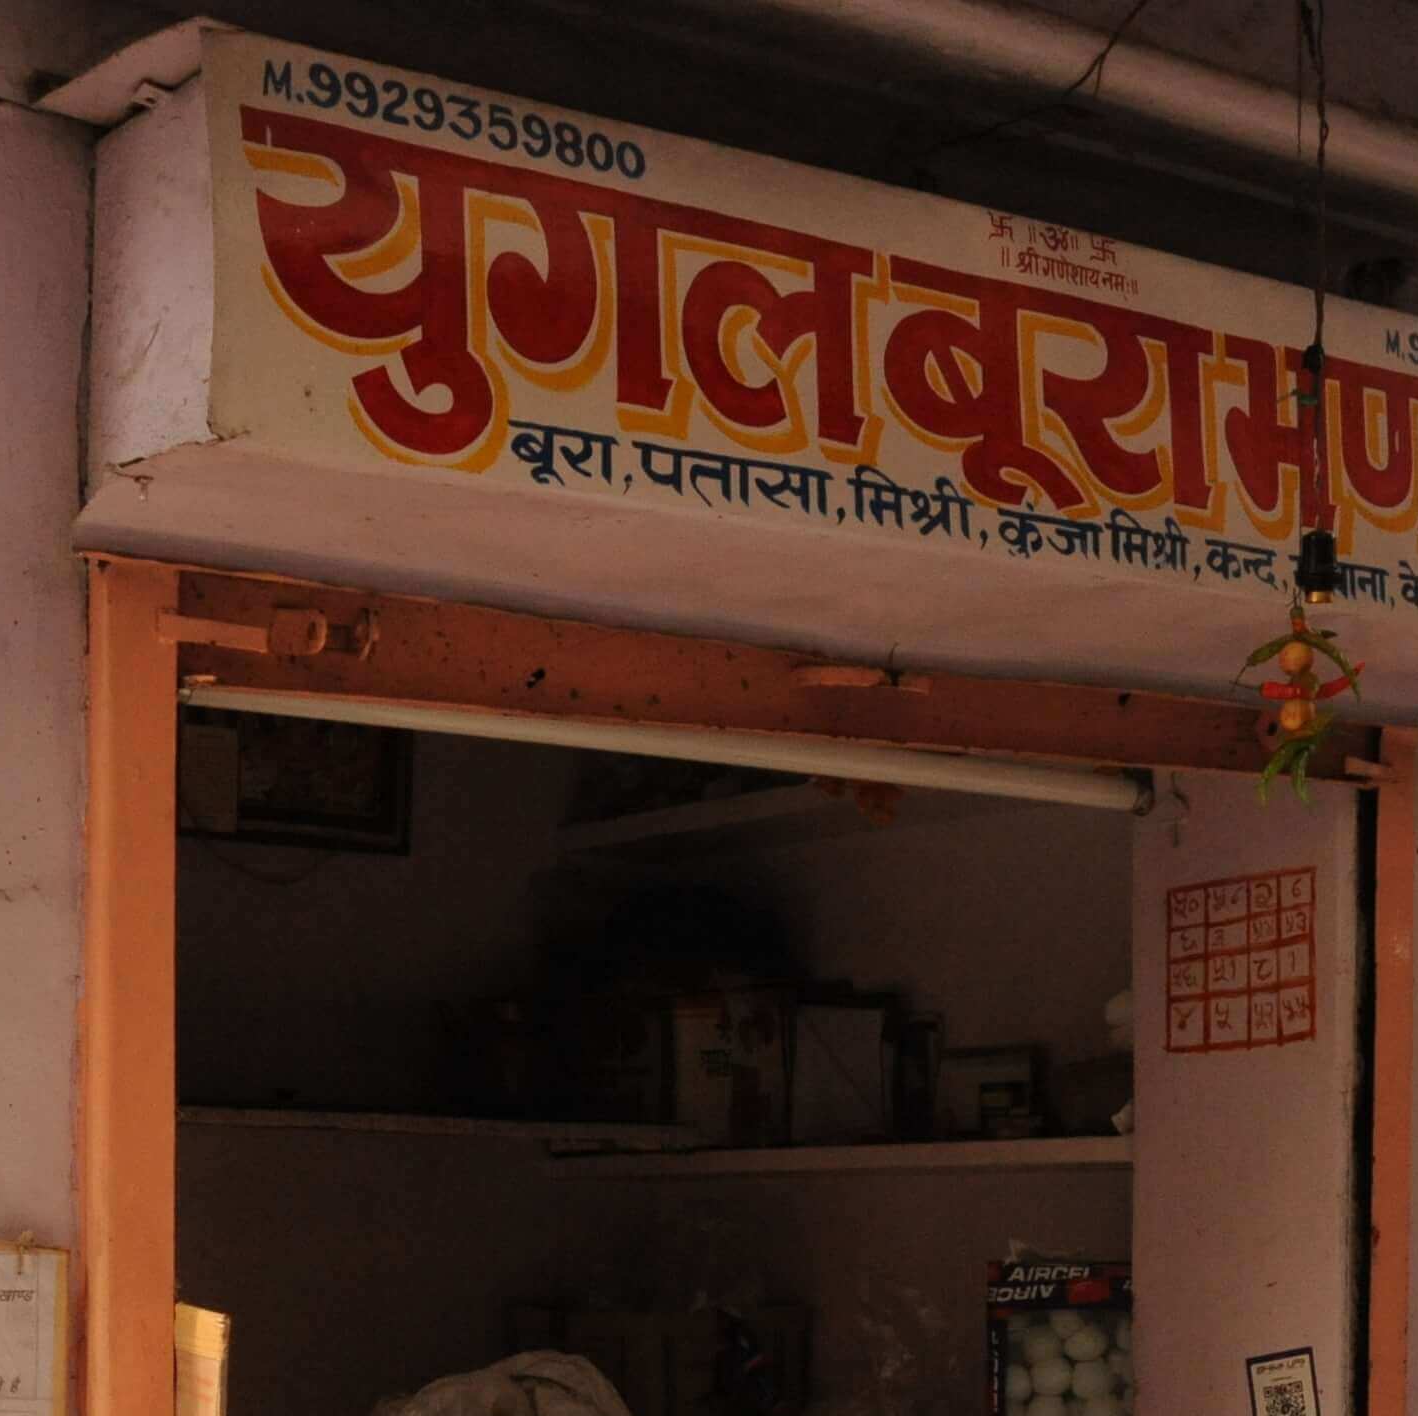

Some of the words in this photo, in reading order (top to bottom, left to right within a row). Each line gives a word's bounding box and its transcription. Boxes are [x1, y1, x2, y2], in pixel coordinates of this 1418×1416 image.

[262, 59, 645, 180] M.9929359800
[240, 106, 886, 468] युगल
[882, 256, 1221, 528] बूरा
